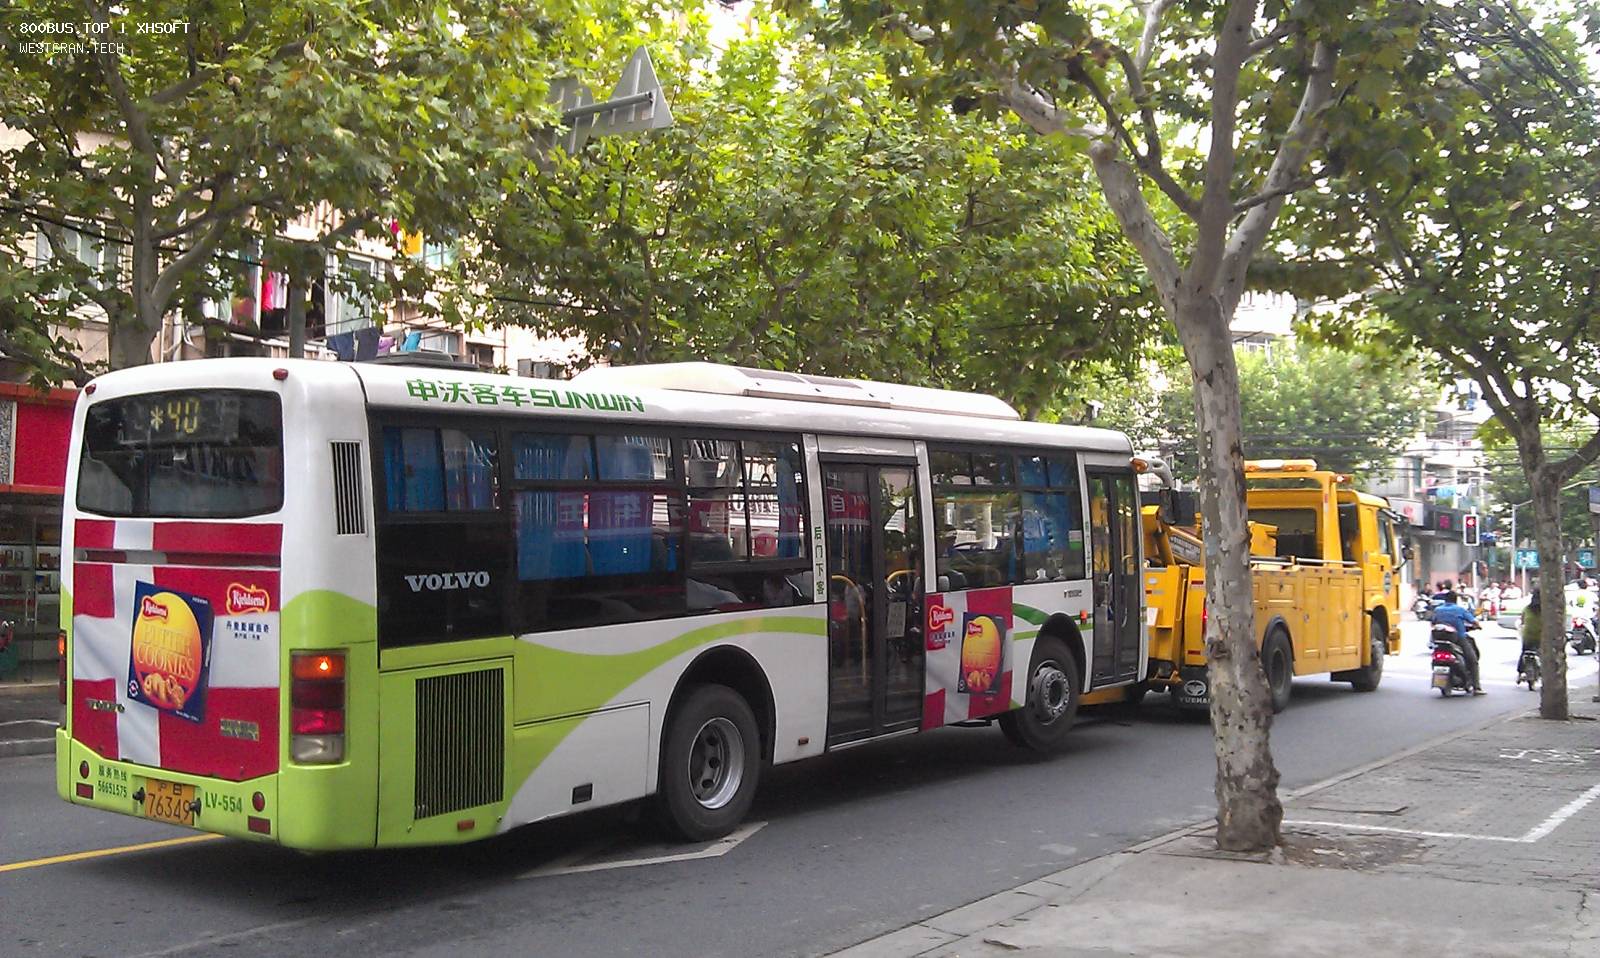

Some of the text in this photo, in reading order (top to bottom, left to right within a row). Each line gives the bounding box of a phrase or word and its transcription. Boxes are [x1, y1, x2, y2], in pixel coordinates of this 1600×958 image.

[406, 378, 645, 412] 申沃客车 SUNWIN
[404, 570, 490, 592] VOLVO
[97, 780, 128, 798] 56651575
[147, 793, 191, 821] 76349
[204, 791, 243, 813] LV-554
